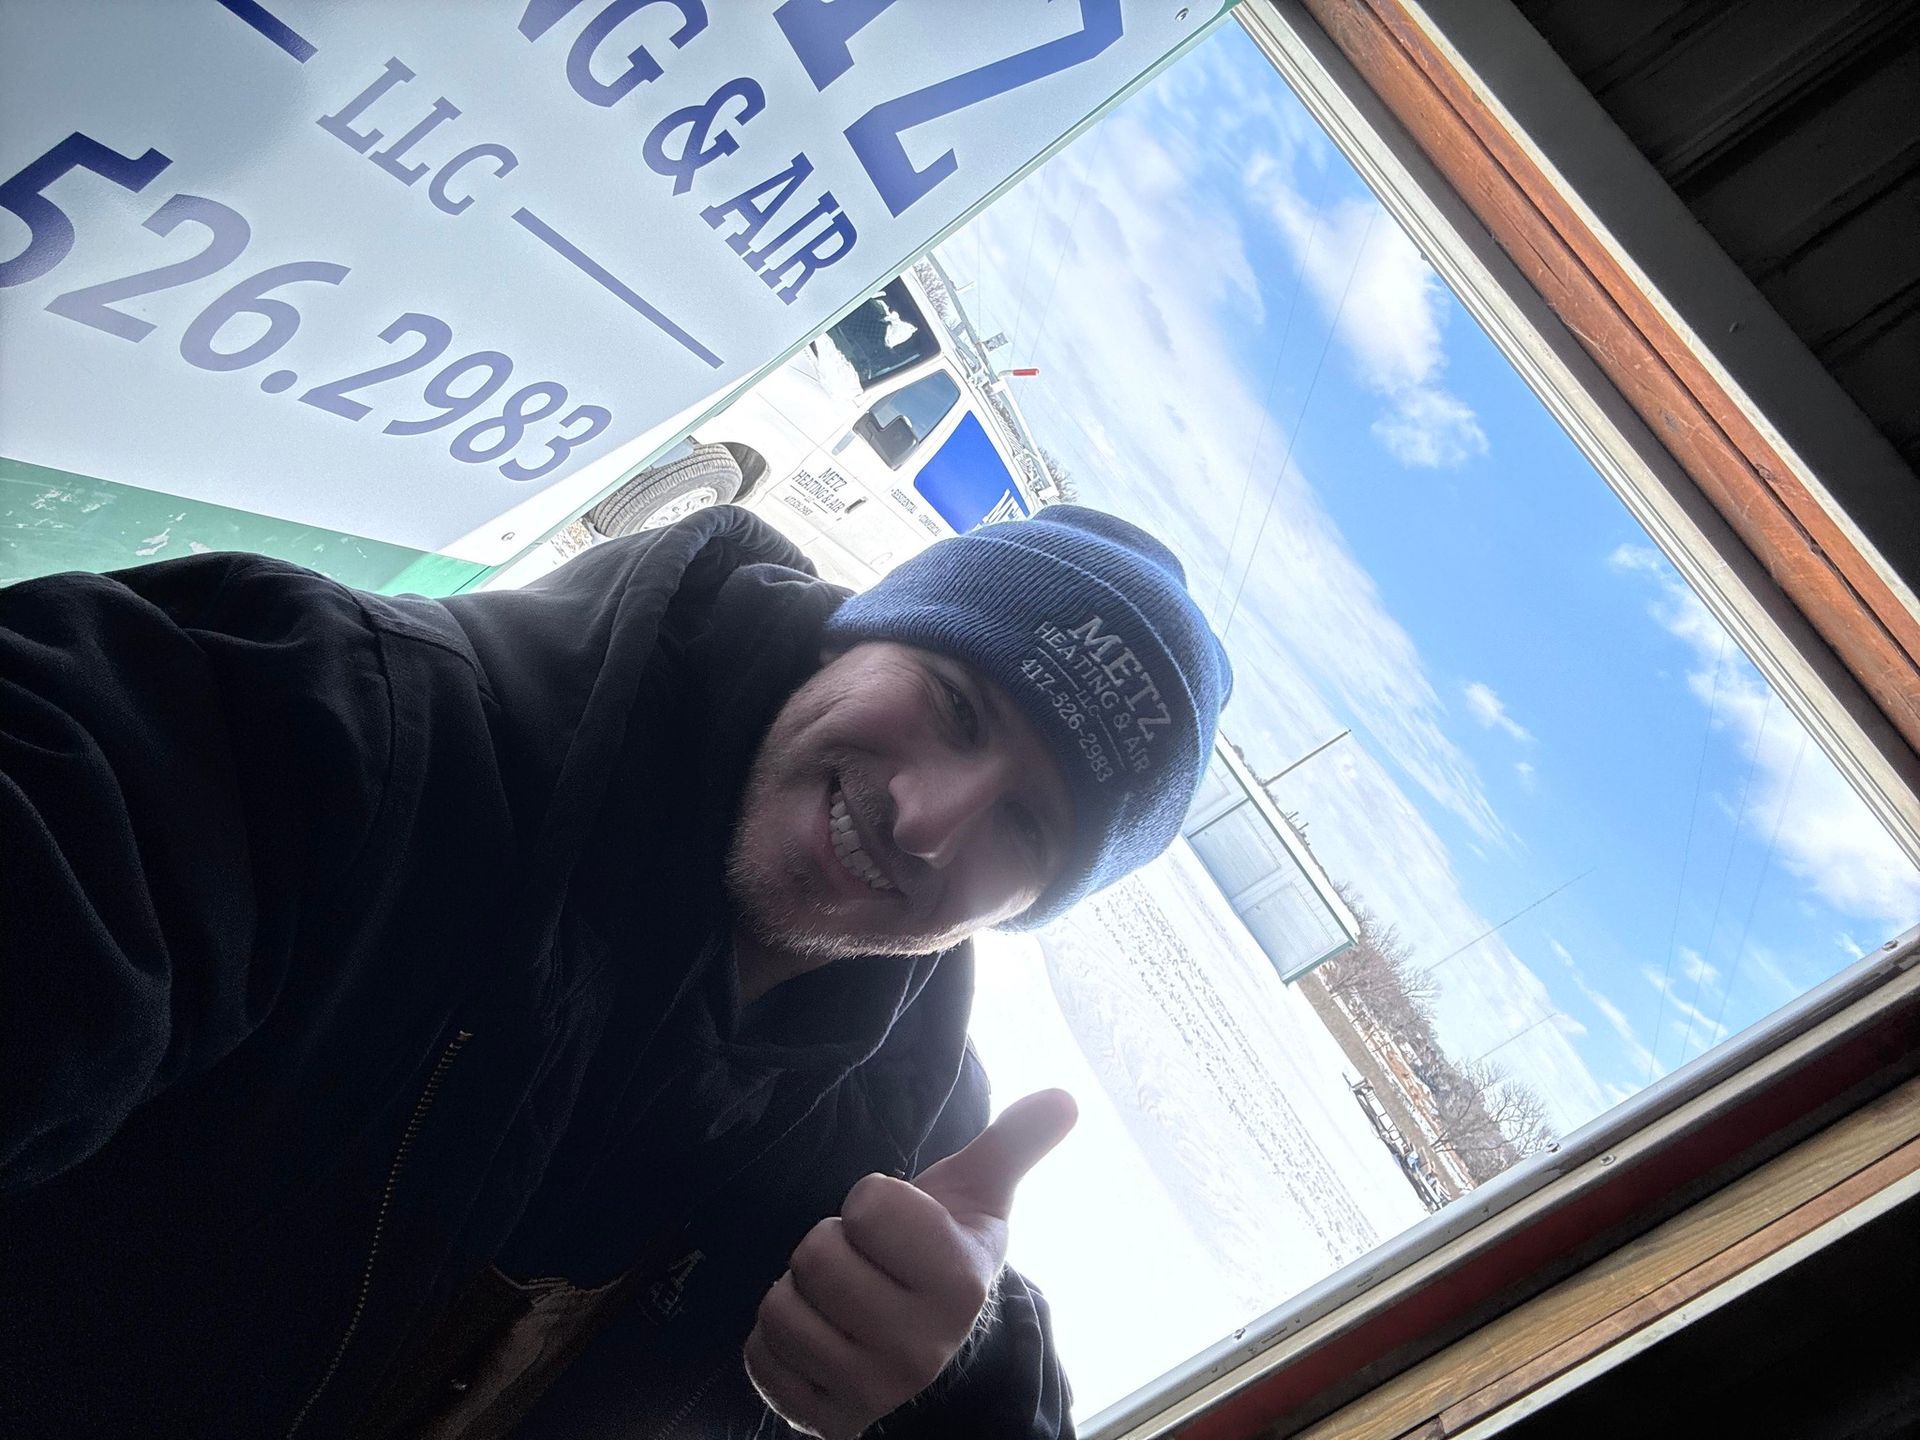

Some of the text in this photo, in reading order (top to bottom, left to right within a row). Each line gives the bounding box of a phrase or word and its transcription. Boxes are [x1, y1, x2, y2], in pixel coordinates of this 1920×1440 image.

[315, 56, 519, 216] LLC
[642, 77, 766, 196] &
[700, 152, 858, 305] AIR
[0, 130, 612, 482] 526.2983
[792, 469, 829, 499] HEATING
[818, 467, 848, 492] METZ
[821, 494, 834, 504] &
[826, 498, 845, 513] AIR
[1020, 658, 1113, 782] 417-526-2983
[1034, 621, 1150, 773] HEATING & AIR
[1067, 615, 1171, 742] METZ
[1075, 689, 1100, 717] LLC
